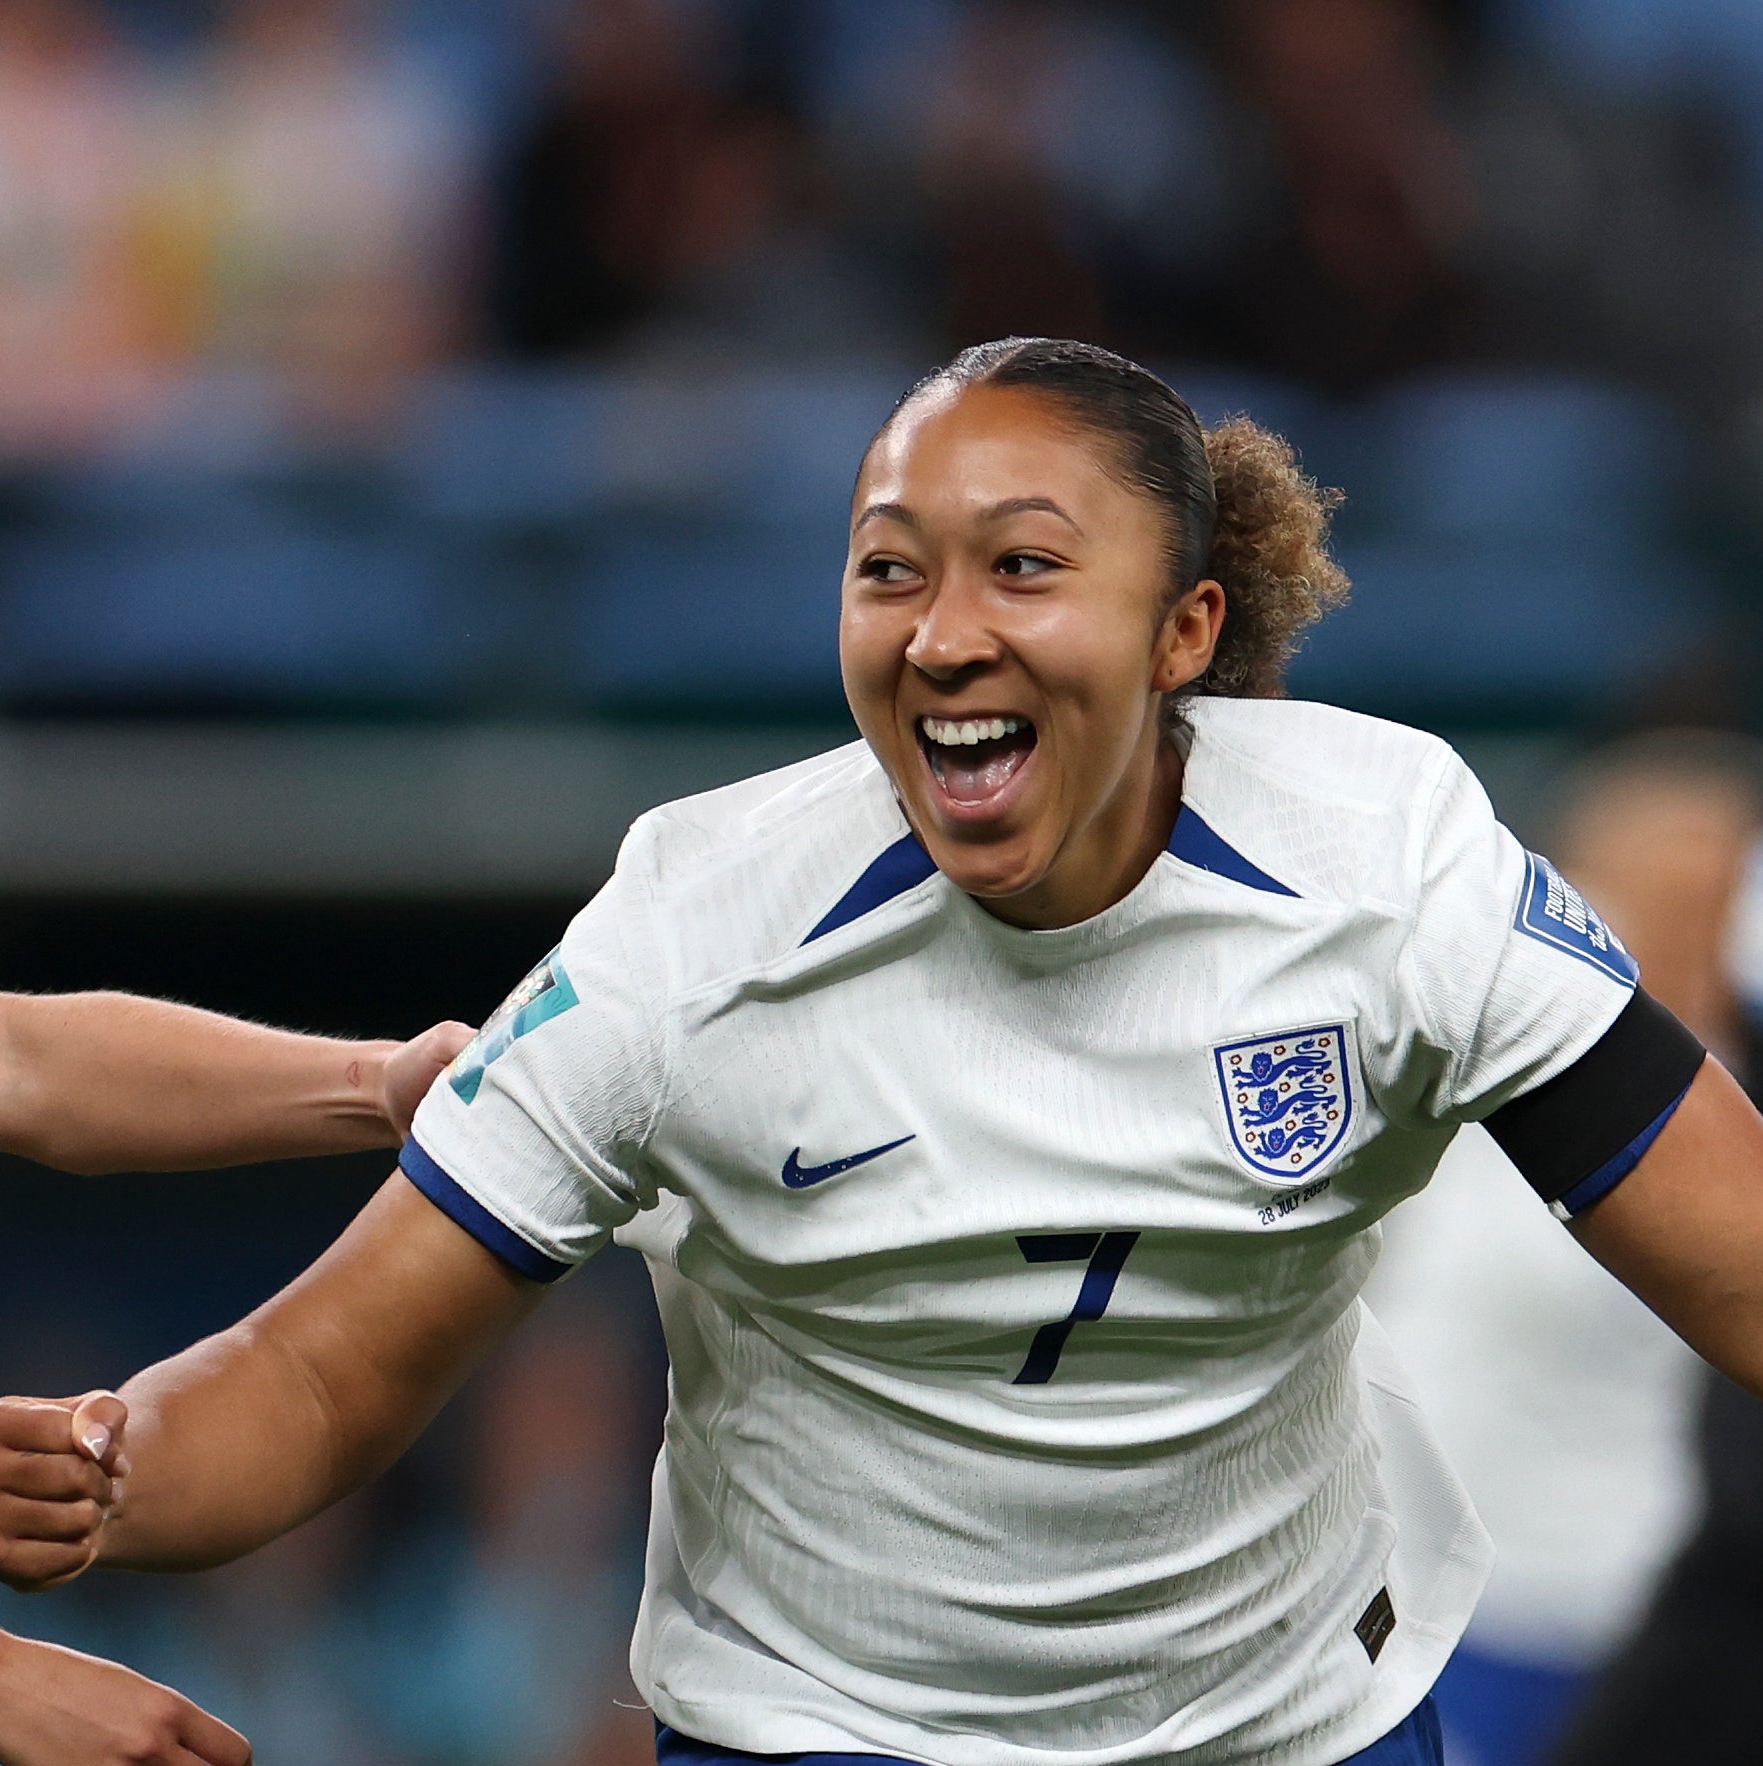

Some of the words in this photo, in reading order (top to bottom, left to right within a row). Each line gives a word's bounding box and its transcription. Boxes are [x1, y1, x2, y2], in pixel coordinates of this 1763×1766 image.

[1258, 1206, 1276, 1226] 28
[1276, 1192, 1300, 1217] JULY
[1011, 1231, 1142, 1385] 7
